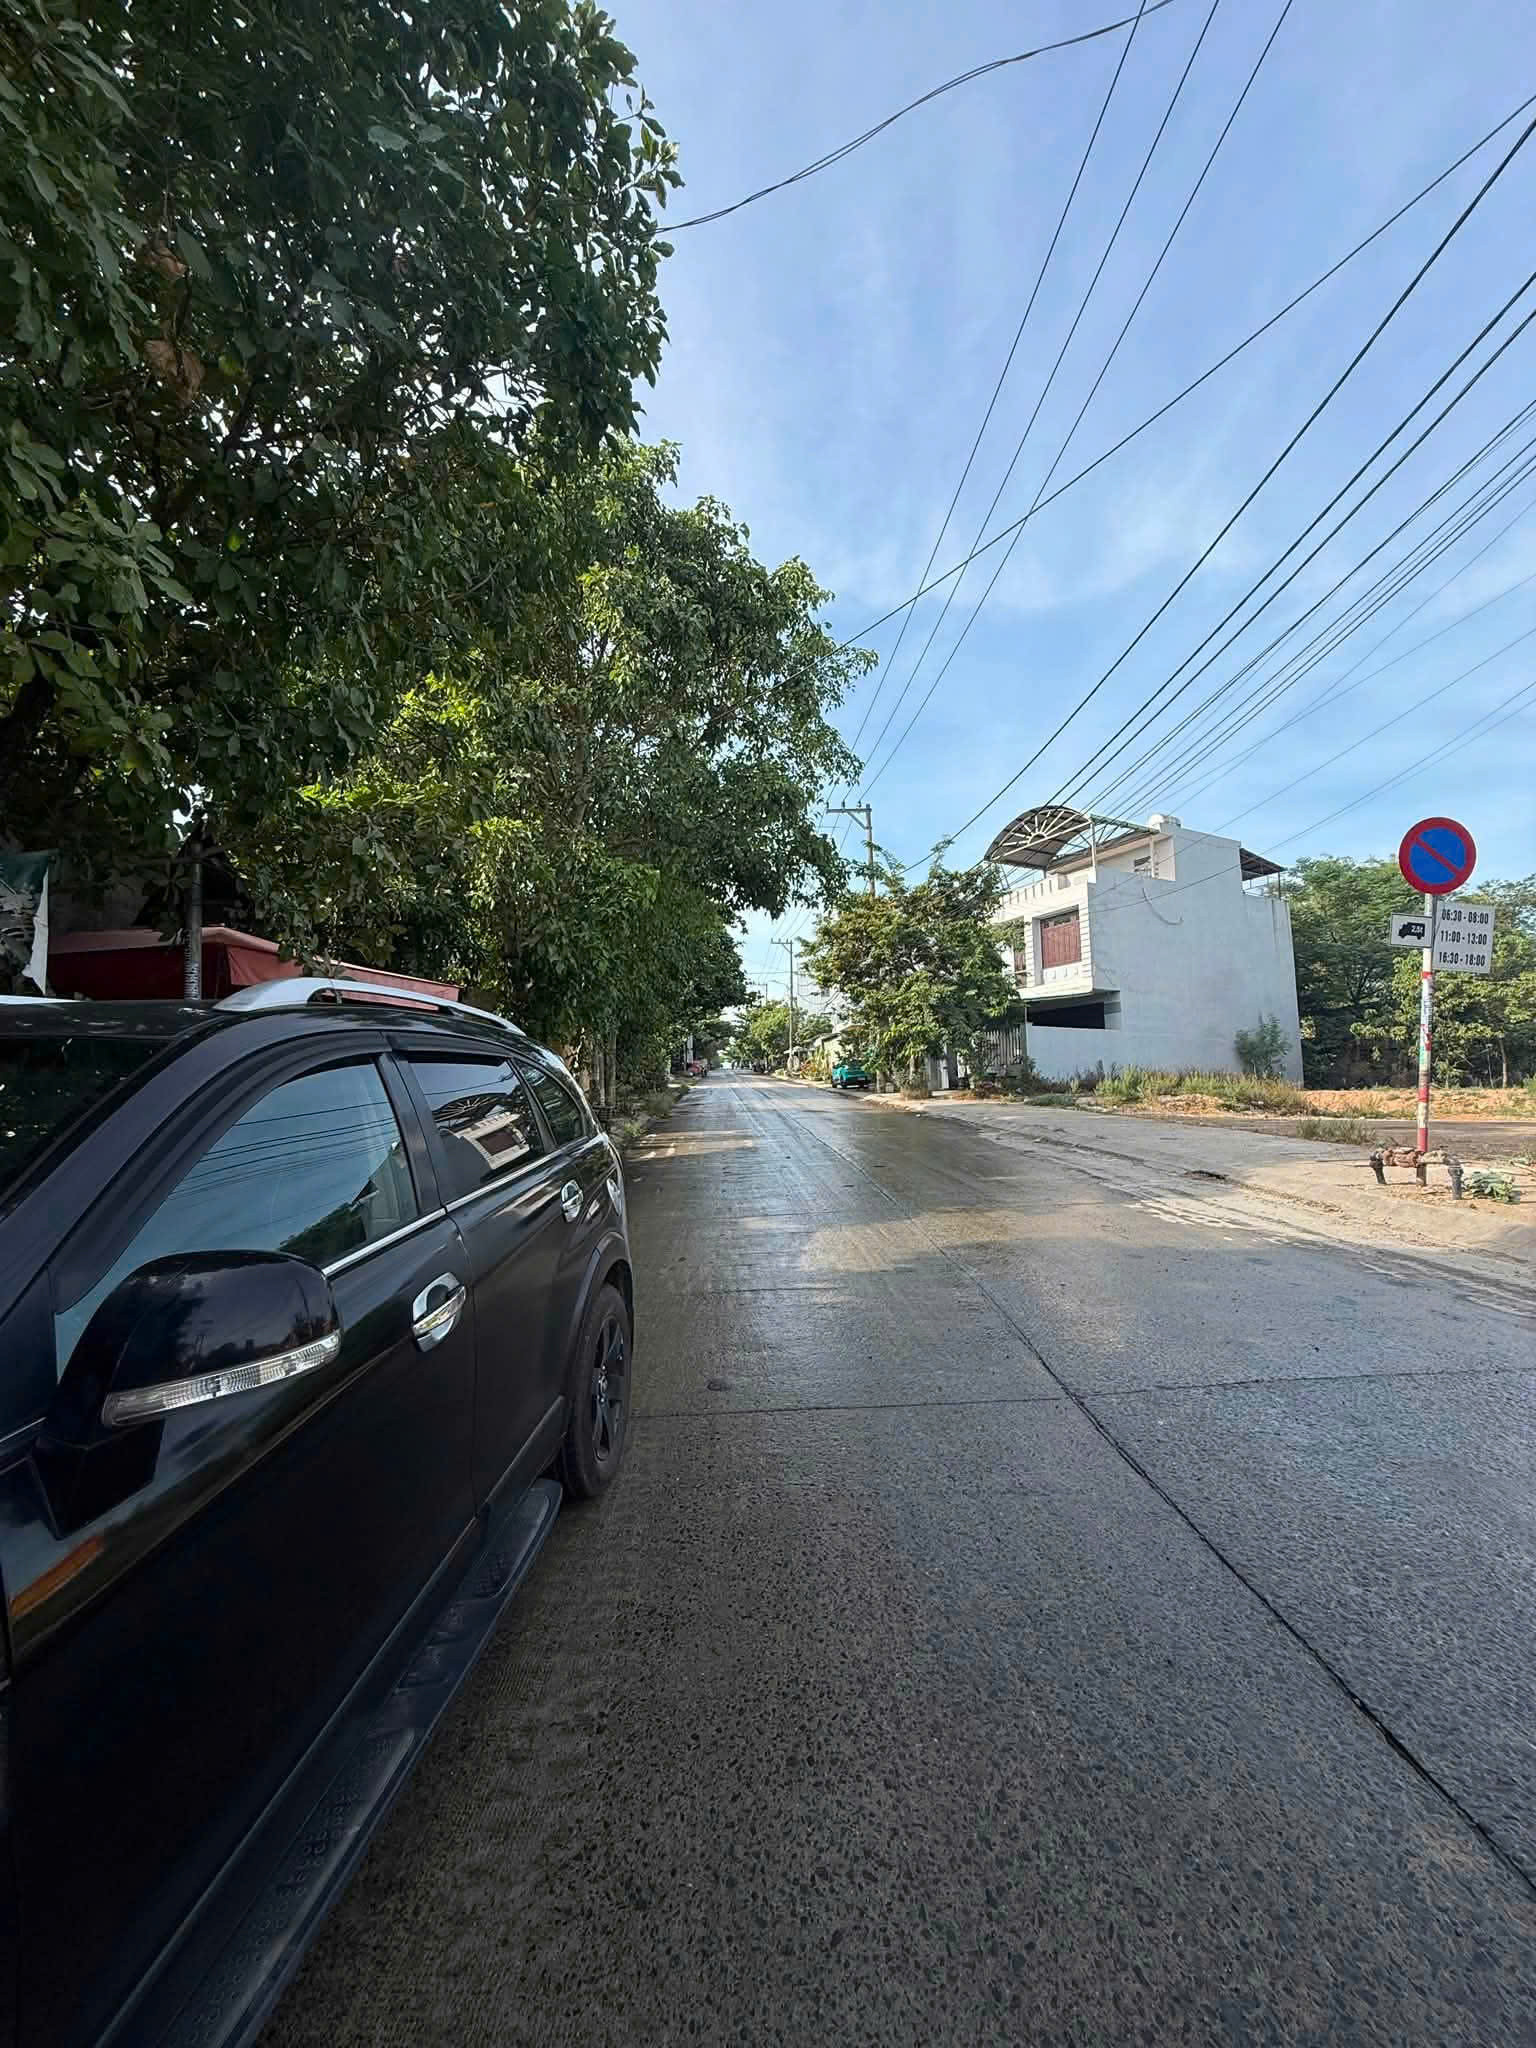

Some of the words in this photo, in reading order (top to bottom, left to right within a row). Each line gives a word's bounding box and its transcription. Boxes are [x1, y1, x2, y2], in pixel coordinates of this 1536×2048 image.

[1441, 909, 1463, 922] 06:30
[1468, 911, 1489, 924] 08:00
[1440, 930, 1461, 943] 11:00
[1467, 932, 1488, 945] 13:00
[1439, 951, 1459, 965] 16:30
[1465, 954, 1486, 967] 18:00
